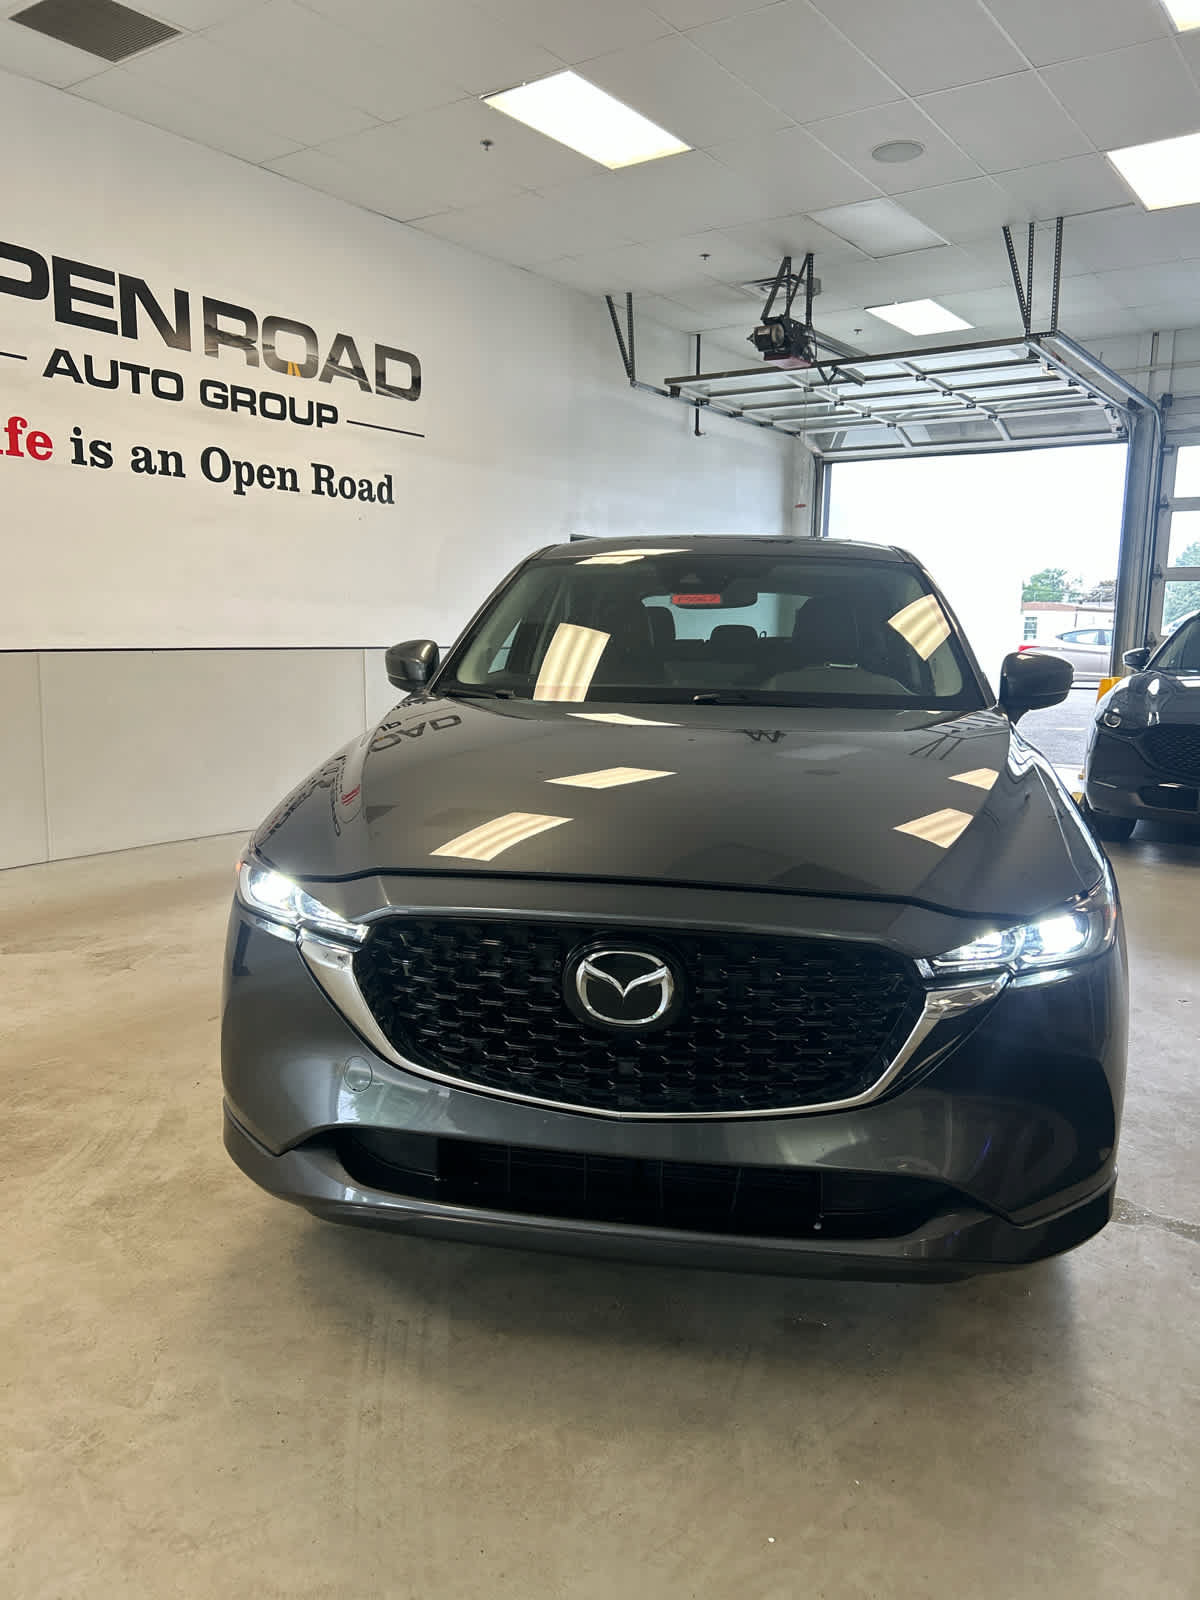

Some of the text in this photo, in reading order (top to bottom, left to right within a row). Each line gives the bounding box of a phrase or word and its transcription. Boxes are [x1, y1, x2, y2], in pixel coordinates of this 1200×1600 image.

[43, 348, 338, 428] AUTO GROUP
[203, 296, 422, 402] ROAD
[0, 416, 395, 505] fe is an Open Road
